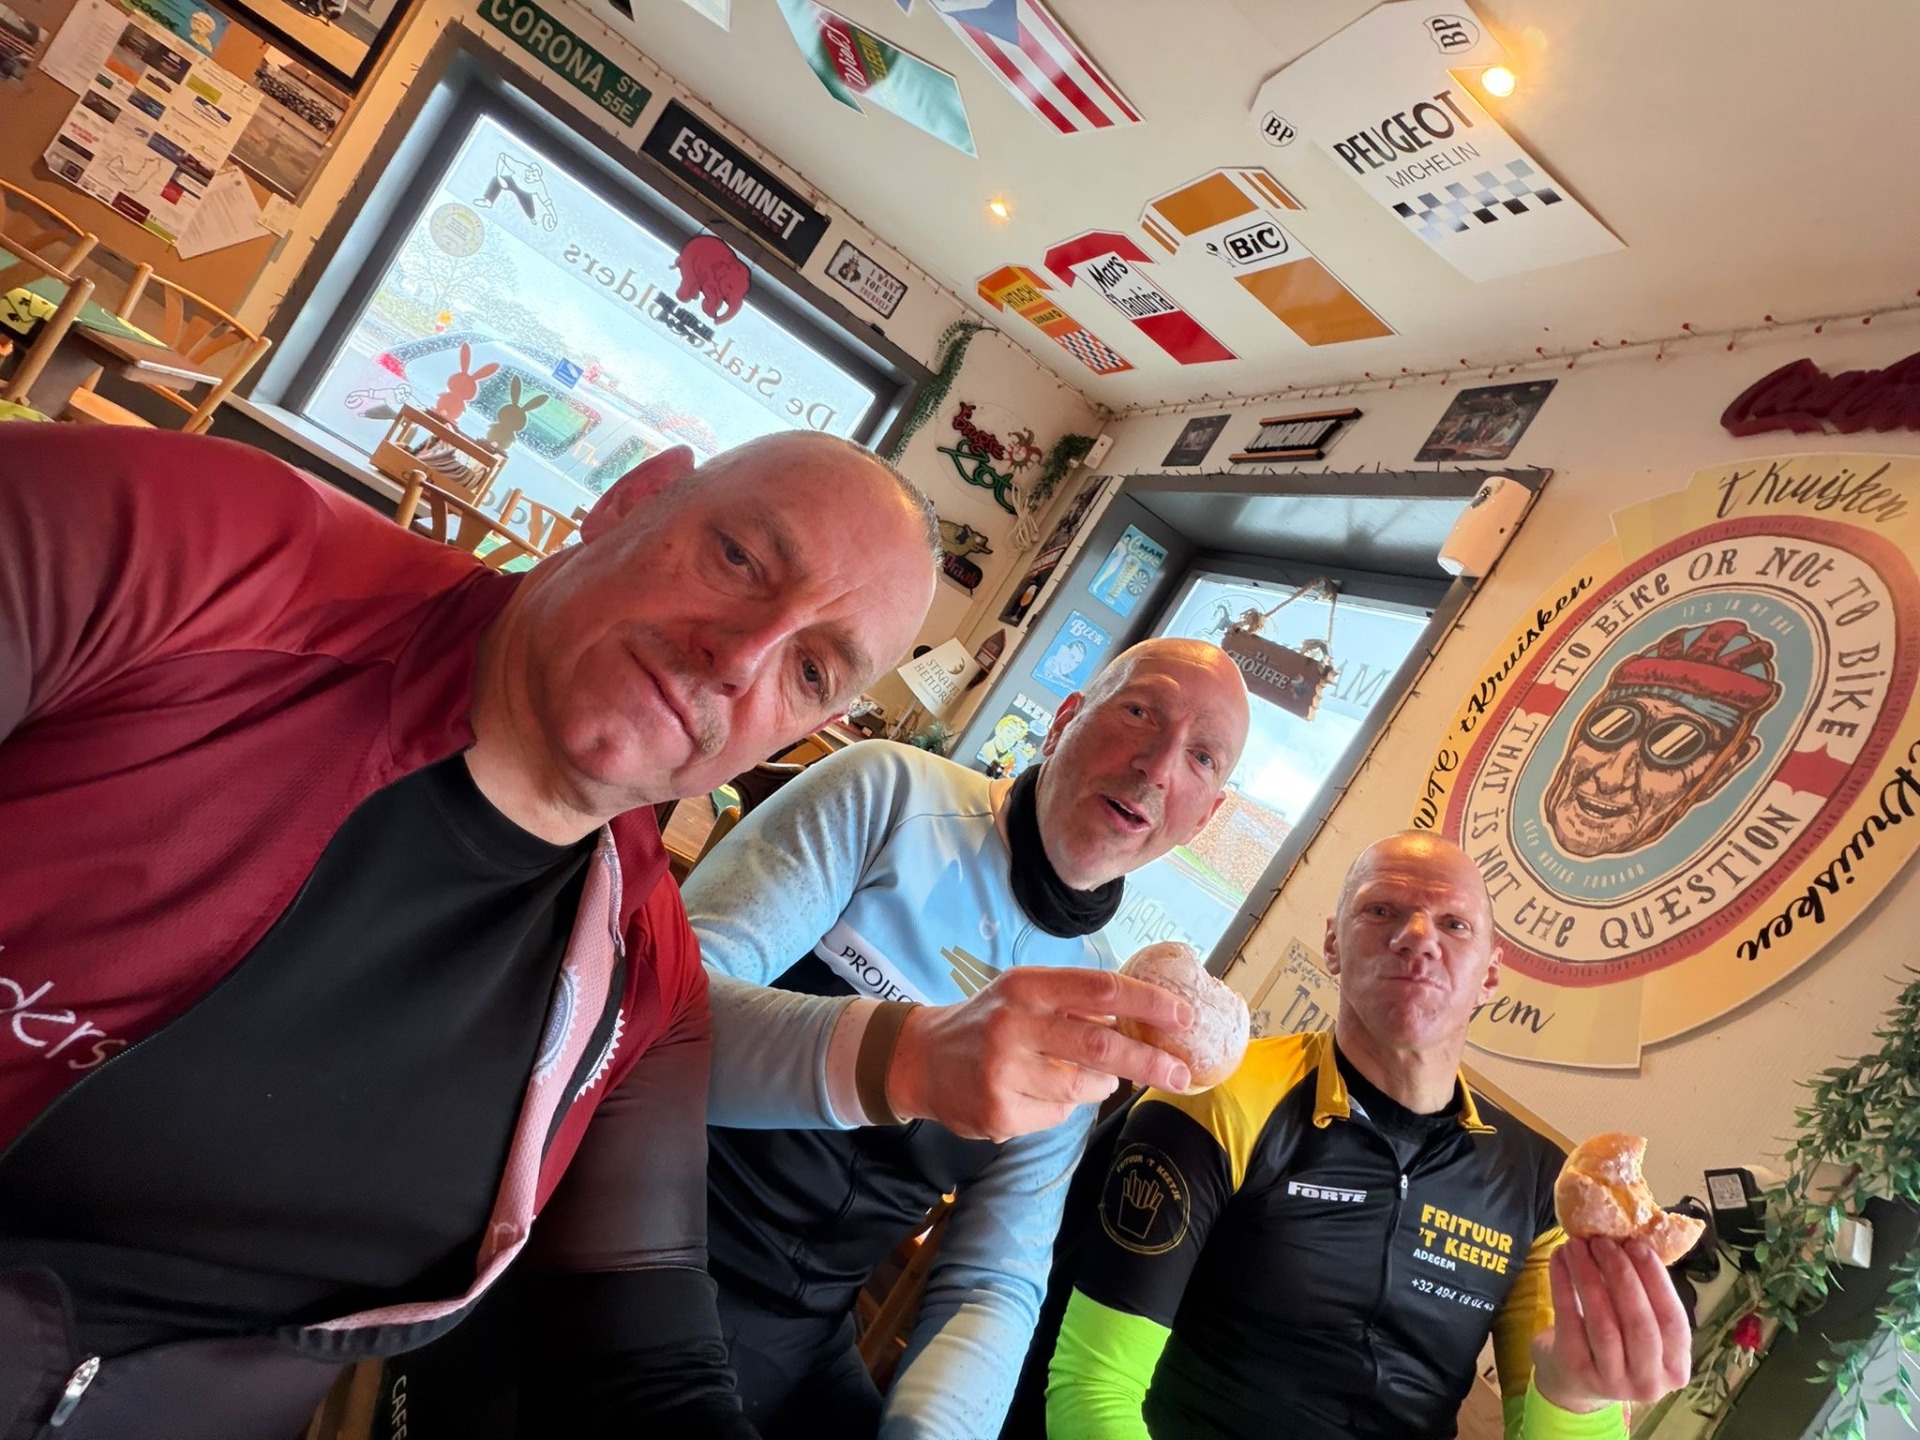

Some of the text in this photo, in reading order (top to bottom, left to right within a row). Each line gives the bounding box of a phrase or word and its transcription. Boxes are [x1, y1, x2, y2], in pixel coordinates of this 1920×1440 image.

[490, 0, 602, 95] CORONA
[1431, 18, 1472, 49] BP
[616, 74, 642, 100] ST
[600, 87, 634, 124] 55E
[1264, 116, 1295, 142] BP
[1332, 89, 1475, 175] PEUGEOT
[1385, 141, 1482, 190] MICHELIN
[668, 126, 806, 242] ESTAMINET
[865, 276, 895, 304] YOU BE
[877, 272, 902, 295] WANT
[1086, 255, 1129, 294] Mars
[860, 286, 889, 311] YOURSELF
[1001, 283, 1043, 309] HITACHI
[1553, 641, 1592, 679] TO
[1688, 548, 1738, 582] OR
[1825, 576, 1881, 628] TO
[1069, 619, 1105, 646] BEER
[1467, 575, 1593, 714] Kruisken
[1227, 649, 1292, 690] CHOUFFE
[1254, 651, 1268, 663] LA
[1481, 719, 1540, 795] THAT
[1474, 845, 1522, 902] NOT
[1583, 863, 1645, 889] FORWARD
[1288, 1181, 1367, 1204] FORTE
[1421, 1204, 1513, 1255] FRITUUR
[1413, 1248, 1456, 1272] ADEGEM
[1445, 1231, 1509, 1276] KEETJE
[1411, 1278, 1434, 1294] +32
[1435, 1286, 1457, 1301] 494
